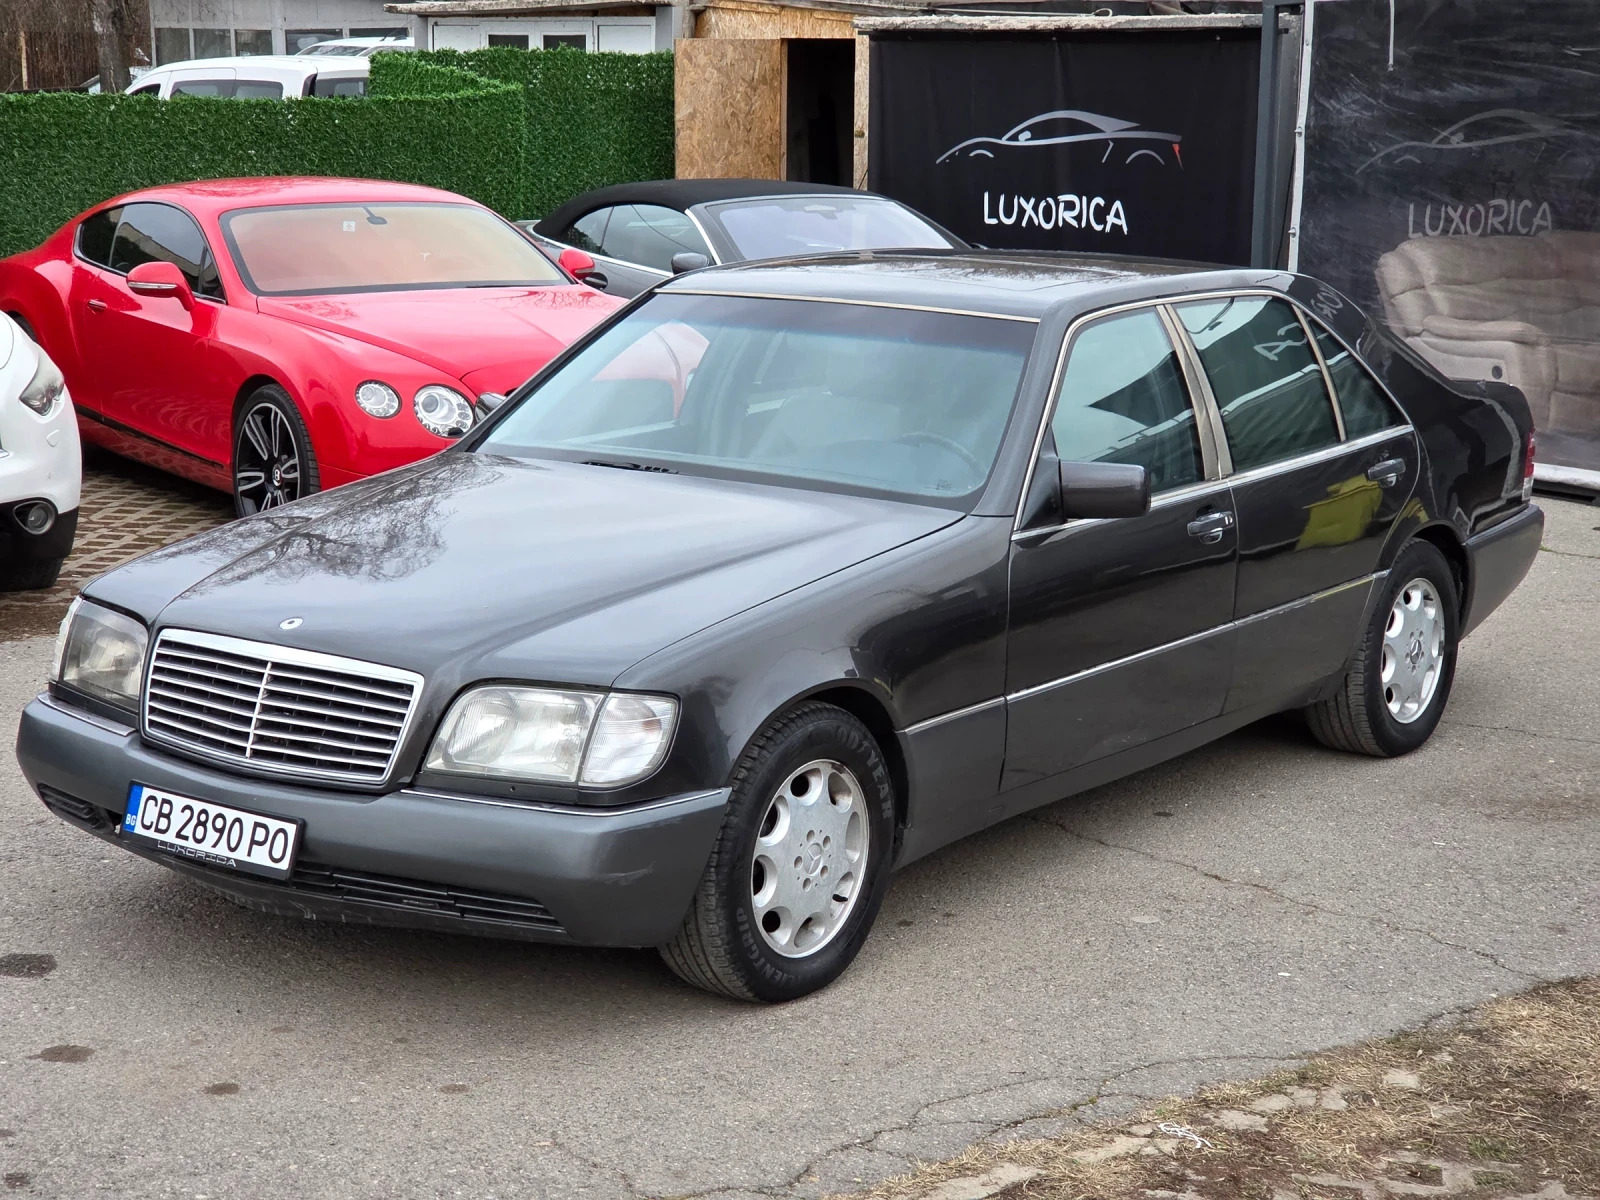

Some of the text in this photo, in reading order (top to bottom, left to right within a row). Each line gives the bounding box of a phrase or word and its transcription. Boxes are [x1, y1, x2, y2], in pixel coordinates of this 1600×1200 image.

[983, 191, 1128, 235] LUXORICA
[1408, 199, 1552, 238] LUXORICA
[828, 723, 893, 820] ODYEAR
[125, 813, 137, 826] BG
[140, 795, 289, 864] CB 2890 PO
[157, 840, 237, 868] LUXORICA
